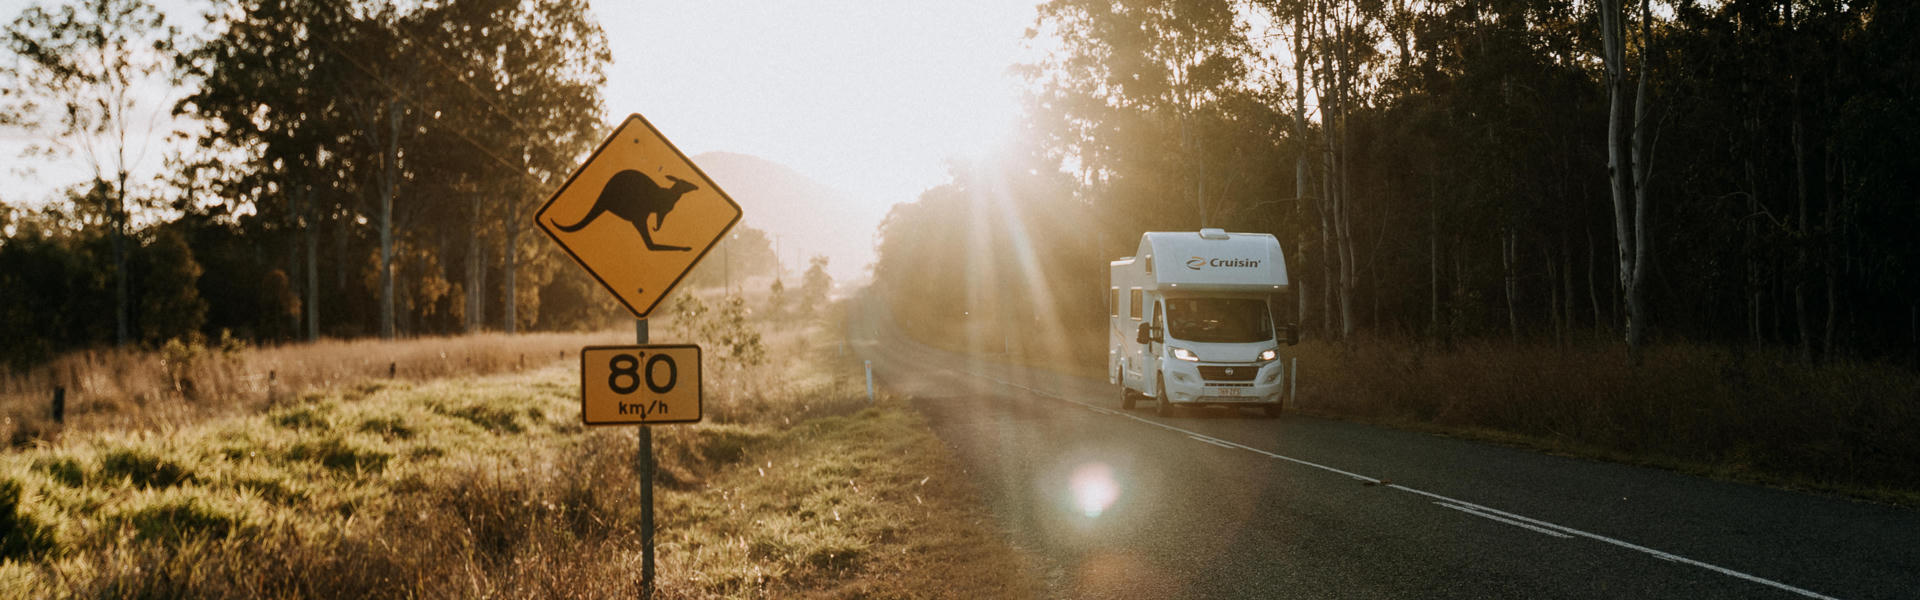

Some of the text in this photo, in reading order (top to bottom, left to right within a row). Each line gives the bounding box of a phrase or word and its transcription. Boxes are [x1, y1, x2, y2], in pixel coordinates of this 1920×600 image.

[1210, 258, 1261, 268] Cruisin'
[608, 353, 677, 394] 80
[619, 400, 668, 415] km/h
